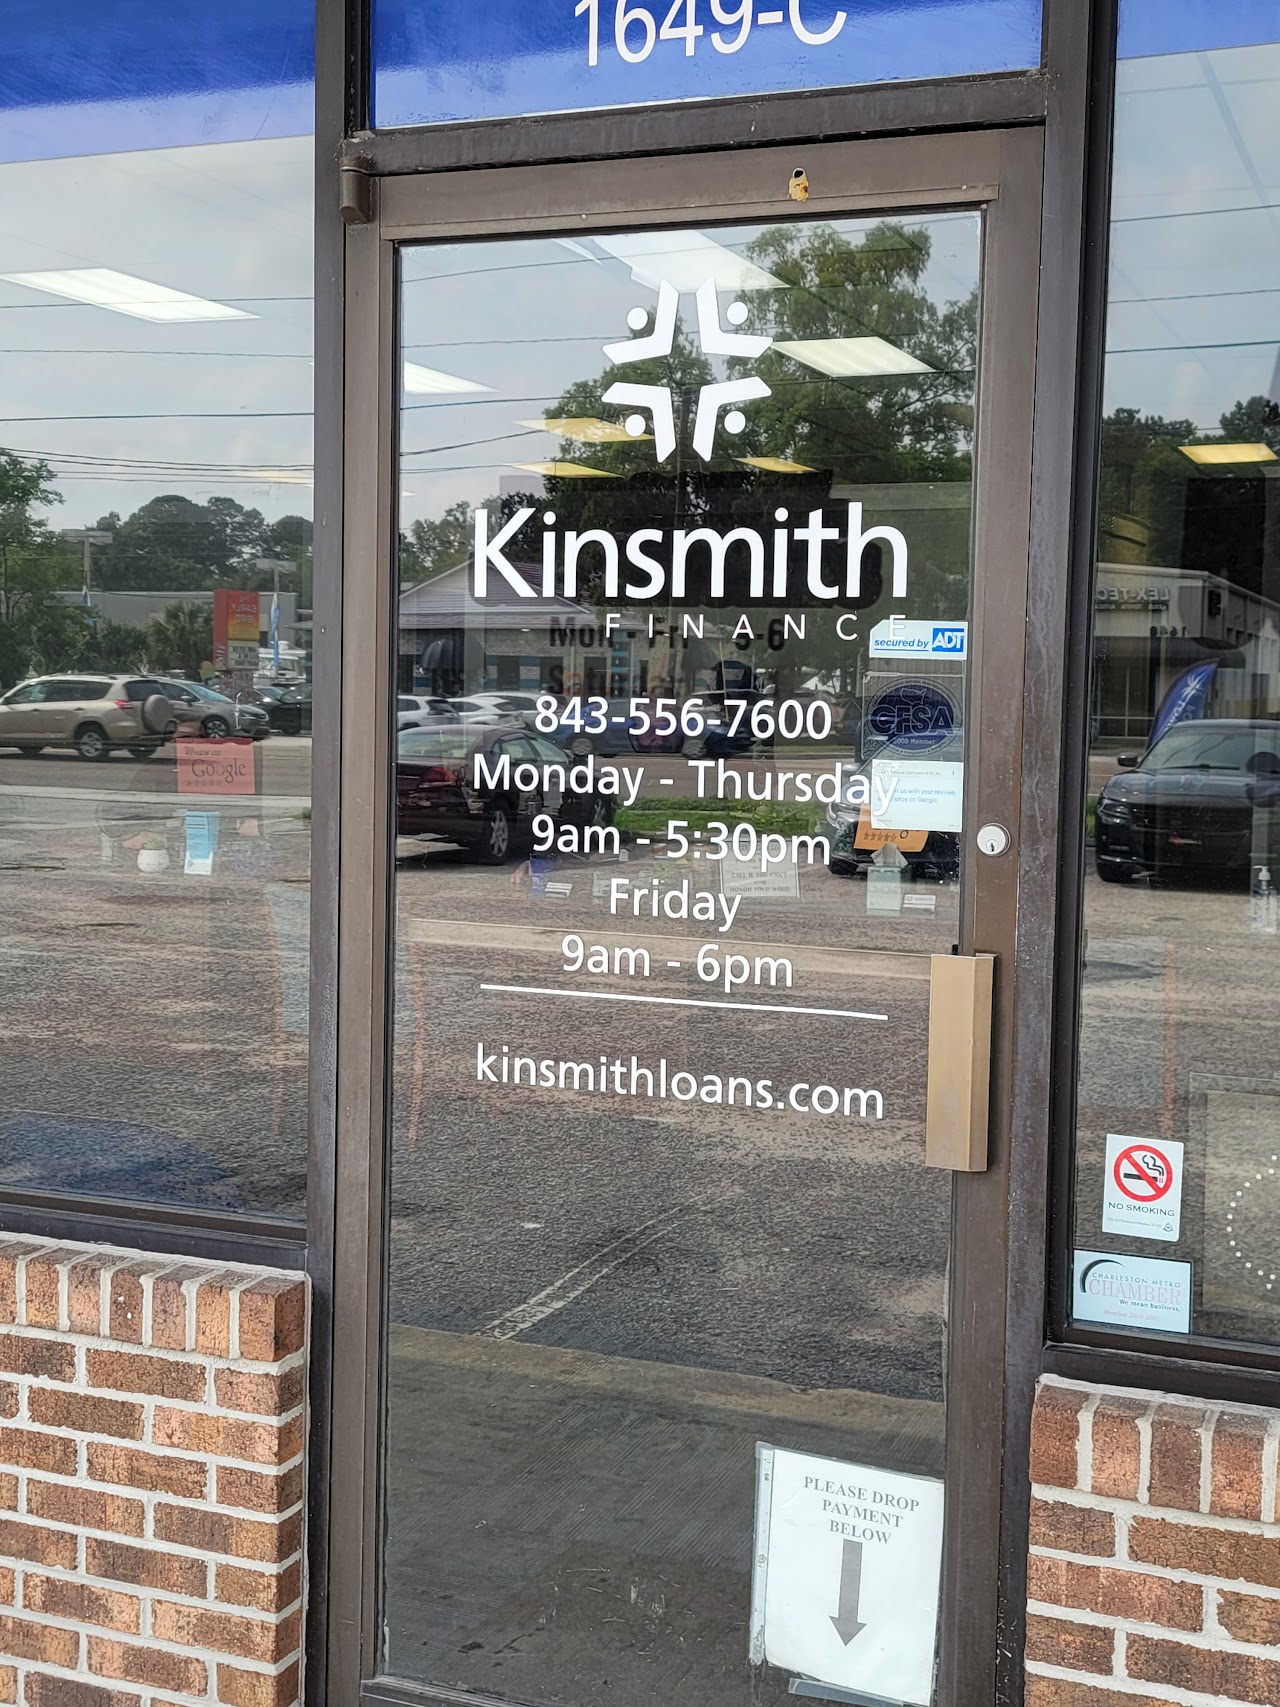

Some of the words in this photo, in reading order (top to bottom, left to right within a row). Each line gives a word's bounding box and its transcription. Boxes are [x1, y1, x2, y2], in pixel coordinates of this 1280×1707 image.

[574, 0, 848, 67] 1649-C
[474, 501, 908, 599] Kinsmith
[606, 613, 906, 641] FINANCE
[874, 638, 915, 648] secured
[916, 638, 930, 649] by
[932, 630, 965, 650] ADT
[534, 695, 832, 740] 843-556-7600
[868, 703, 954, 735] CFSA
[191, 757, 247, 784] Google
[474, 753, 645, 807] Monday
[687, 759, 898, 816] Thursday
[532, 814, 620, 855] 9am
[667, 820, 831, 873] 5:30pm
[610, 877, 743, 932] Friday
[561, 934, 651, 977] 9am
[696, 943, 794, 994] 6pm
[476, 1042, 884, 1120] kinsmithloans.com
[1108, 1202, 1124, 1210] NO
[1125, 1203, 1175, 1217] SMOKING
[1088, 1278, 1182, 1306] CHAMBER
[1092, 1271, 1149, 1285] CHARLESTON
[1151, 1279, 1181, 1289] METRO
[1119, 1298, 1129, 1306] We
[1130, 1300, 1149, 1308] mean
[803, 1475, 868, 1502] PLEASE
[872, 1489, 920, 1512] DROP
[821, 1498, 904, 1528] PAYMENT
[829, 1519, 892, 1545] BELOW
